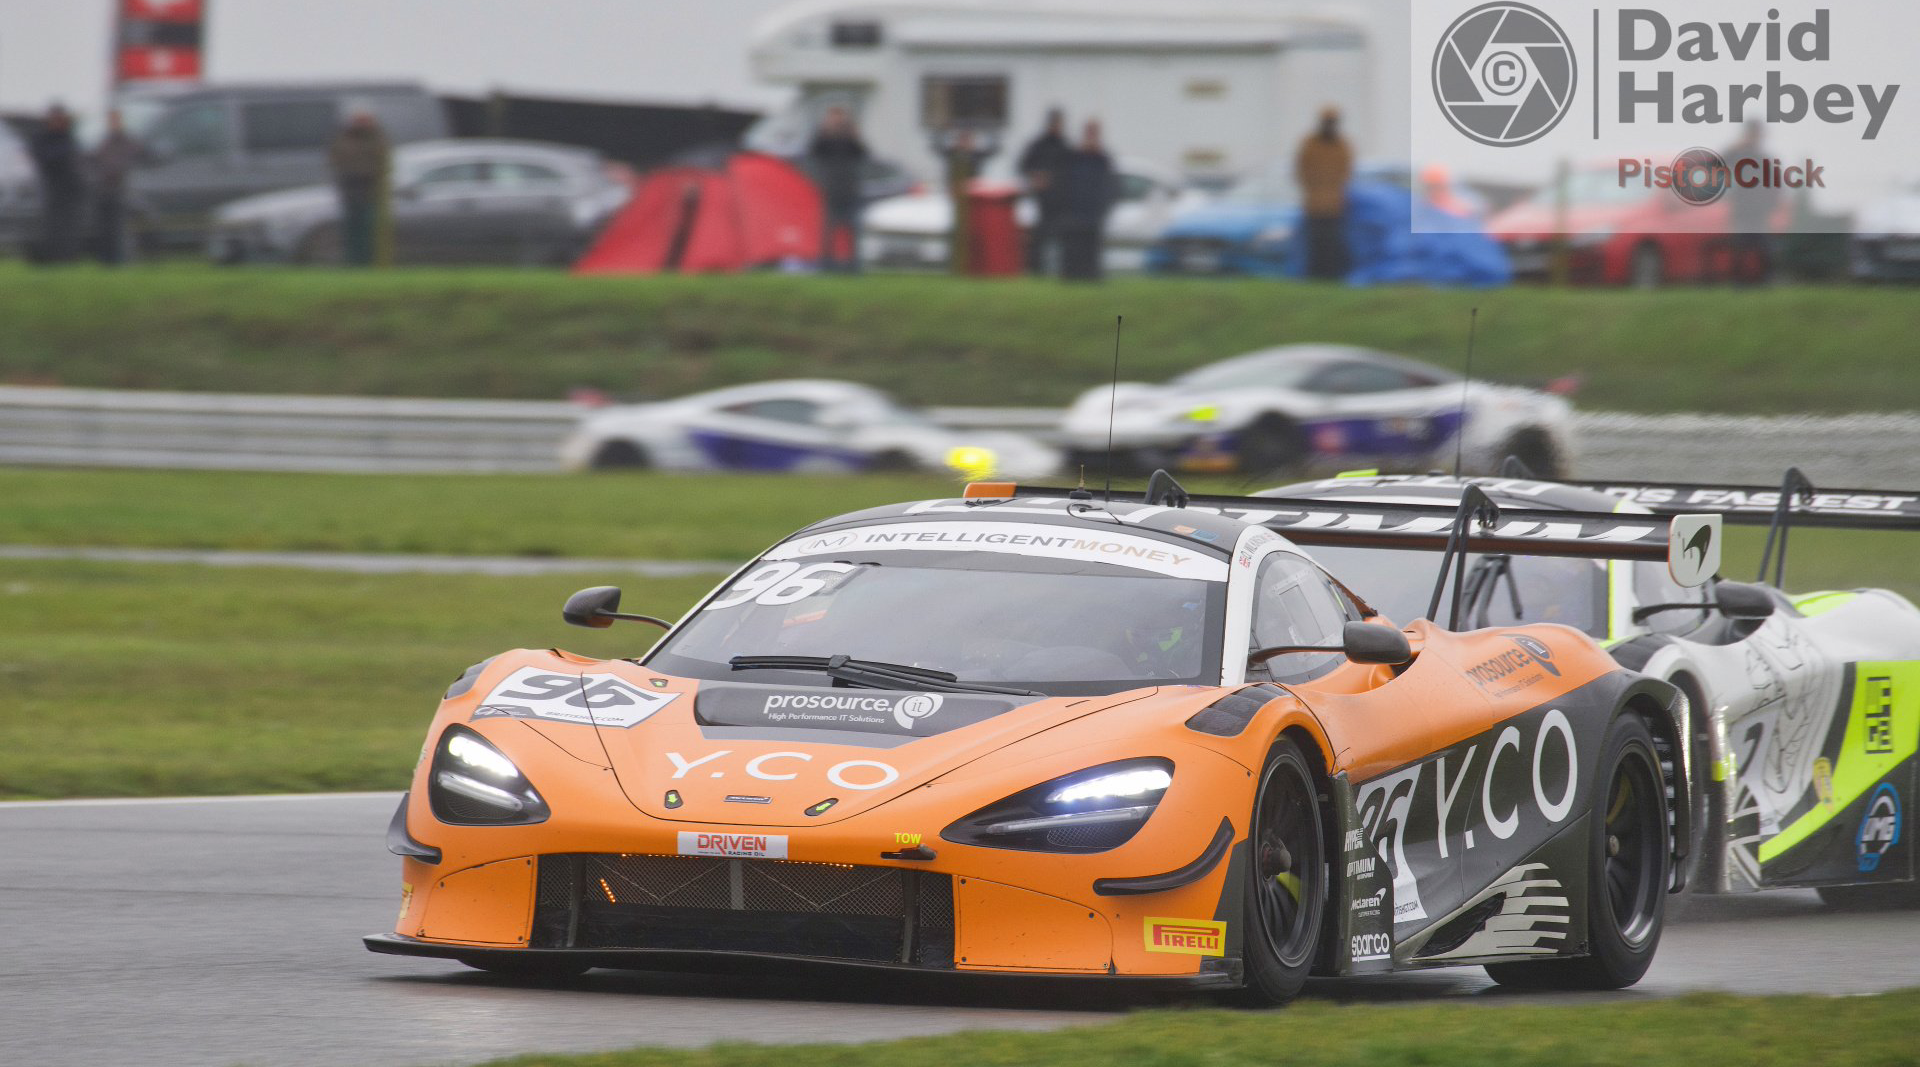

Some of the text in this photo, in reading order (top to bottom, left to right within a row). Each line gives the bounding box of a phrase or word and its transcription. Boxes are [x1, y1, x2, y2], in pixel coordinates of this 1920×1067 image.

[703, 562, 858, 611] 96
[498, 674, 661, 709] 96
[768, 713, 786, 722] High
[788, 713, 837, 721] Performance
[849, 715, 885, 723] Solutions
[665, 750, 900, 790] Y.CO
[1437, 709, 1578, 858] Y.CO
[697, 834, 767, 855] DRIVEN
[895, 833, 922, 844] TOW
[1347, 857, 1376, 878] OPTIMUM
[1351, 897, 1381, 910] McLaren
[1153, 924, 1220, 950] PIRELLI
[1352, 933, 1389, 963] sparco
